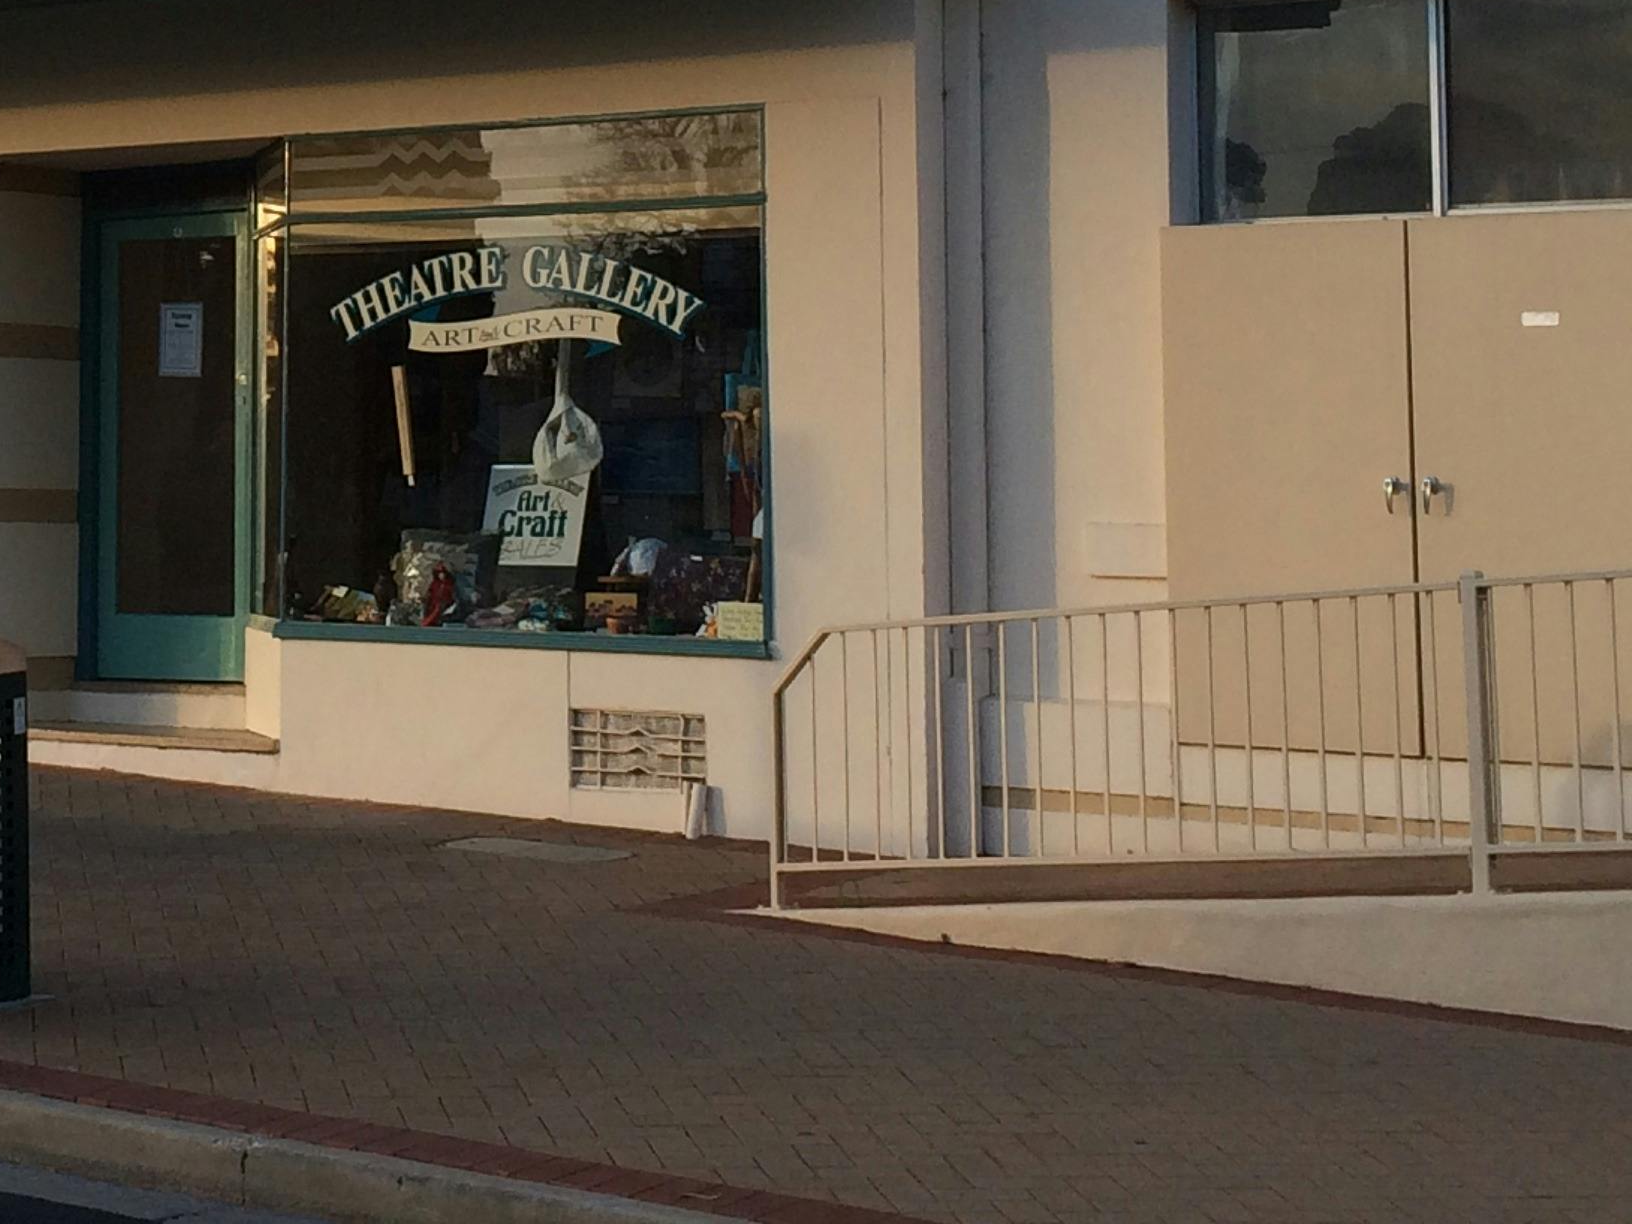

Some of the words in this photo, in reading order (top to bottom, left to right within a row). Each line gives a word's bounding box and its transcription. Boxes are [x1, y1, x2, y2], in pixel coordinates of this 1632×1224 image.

[330, 246, 504, 342] THEATRE
[522, 245, 704, 336] GALLERY
[421, 327, 480, 347] ART
[503, 314, 605, 338] CRAFT
[516, 489, 552, 512] Art
[497, 508, 568, 538] Craft
